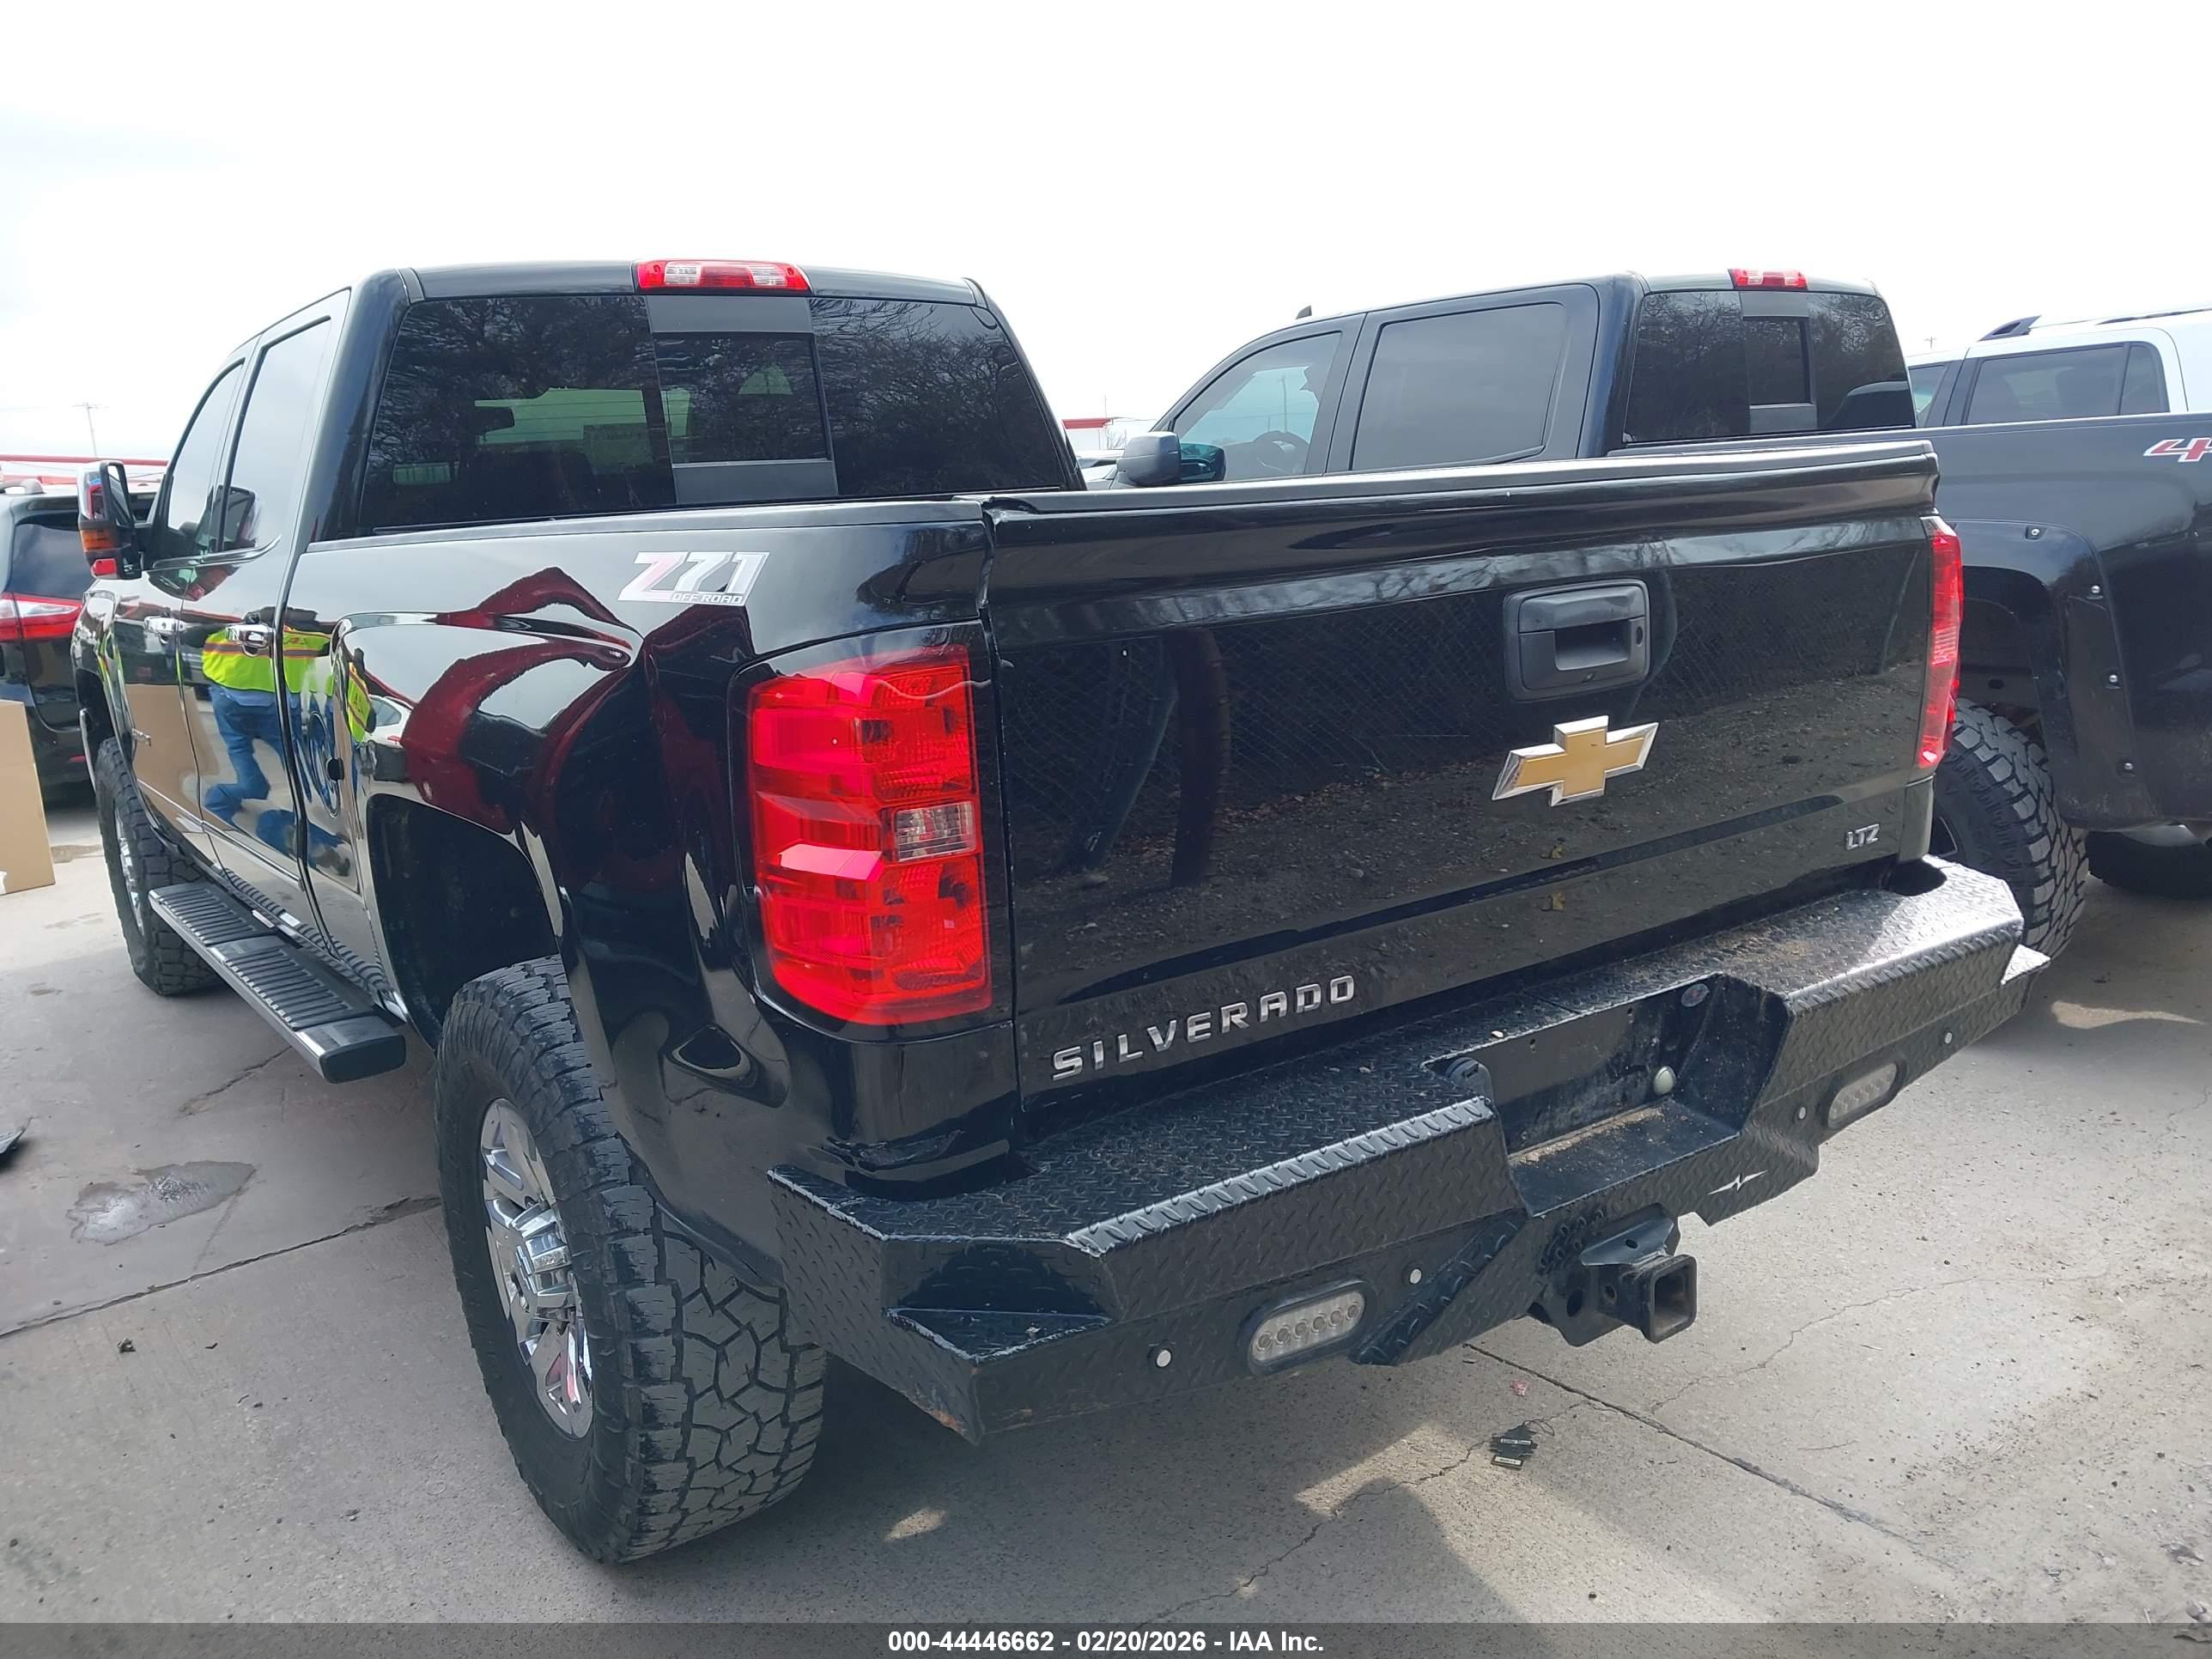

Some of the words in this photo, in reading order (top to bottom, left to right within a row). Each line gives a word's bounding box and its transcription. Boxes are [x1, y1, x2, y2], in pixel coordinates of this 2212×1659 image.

[618, 552, 770, 606] Z71
[672, 592, 699, 601] OFF
[700, 594, 743, 604] ROAD
[1846, 823, 1880, 850] LTZ
[1052, 975, 1355, 1081] SILVERADO
